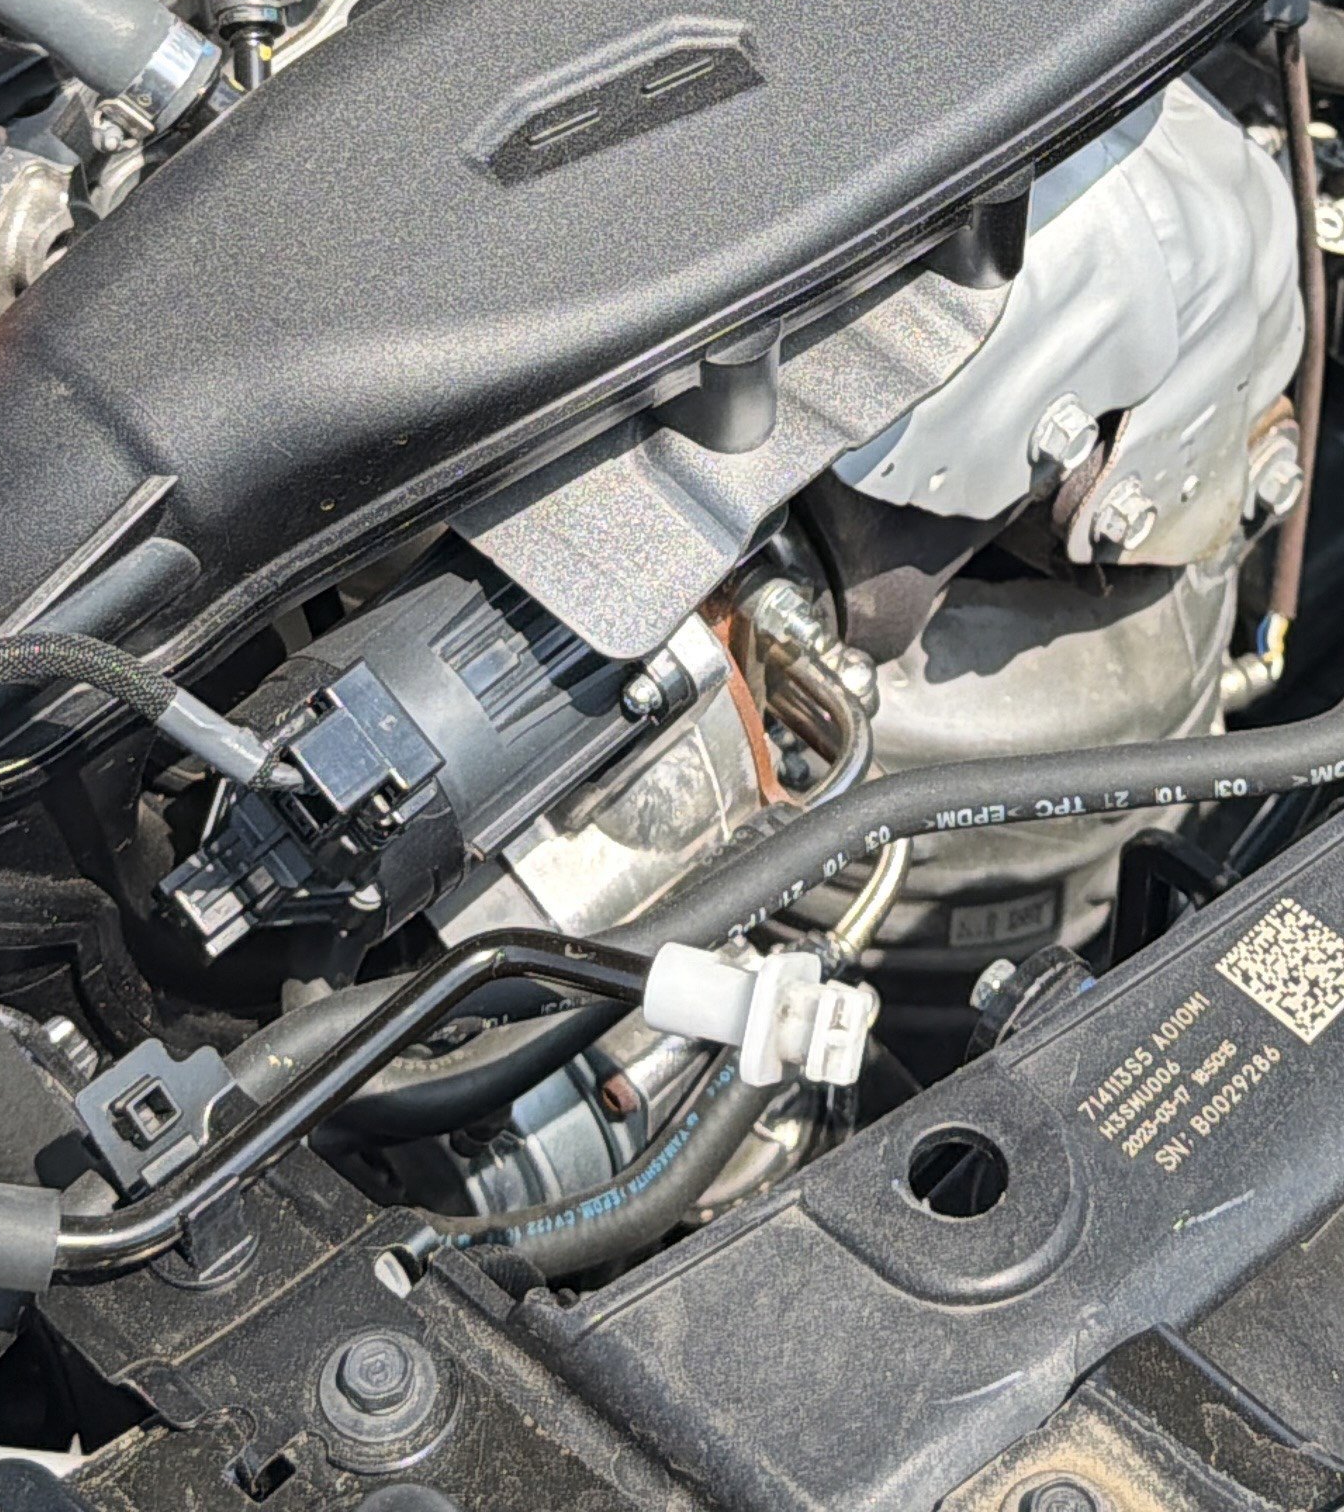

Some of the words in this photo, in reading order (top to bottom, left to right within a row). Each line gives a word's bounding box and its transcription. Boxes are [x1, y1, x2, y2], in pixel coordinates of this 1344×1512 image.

[1035, 796, 1086, 817] TPC
[1077, 1046, 1153, 1122] 714113S5
[1151, 991, 1212, 1051] A010M1
[1189, 1044, 1281, 1137] B0029286
[1099, 1058, 1181, 1141] H3SMU006
[1121, 1084, 1191, 1158] 2023-03-17
